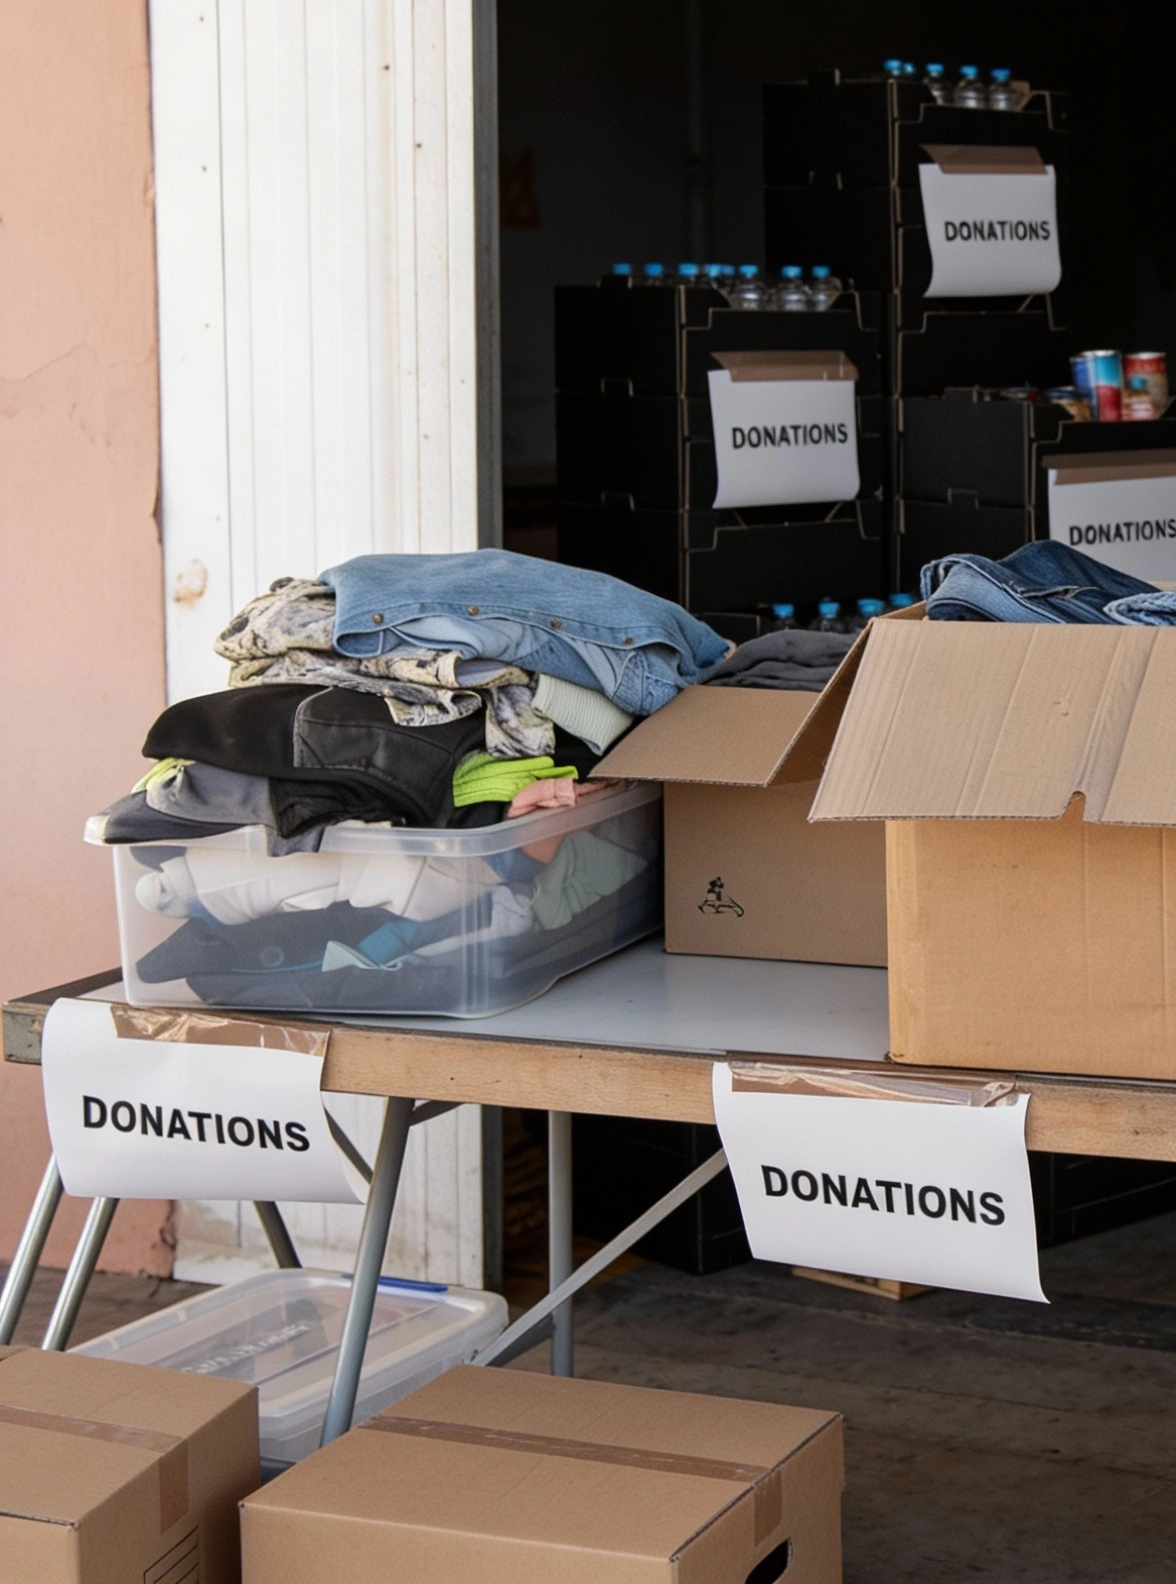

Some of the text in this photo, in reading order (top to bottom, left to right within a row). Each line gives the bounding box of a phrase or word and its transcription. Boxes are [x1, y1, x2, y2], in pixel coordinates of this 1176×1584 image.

[944, 220, 1050, 242] DONATIONS
[731, 422, 849, 449] DONATIONS
[82, 1095, 310, 1152] DONATIONS
[761, 1164, 1005, 1226] DONATIONS
